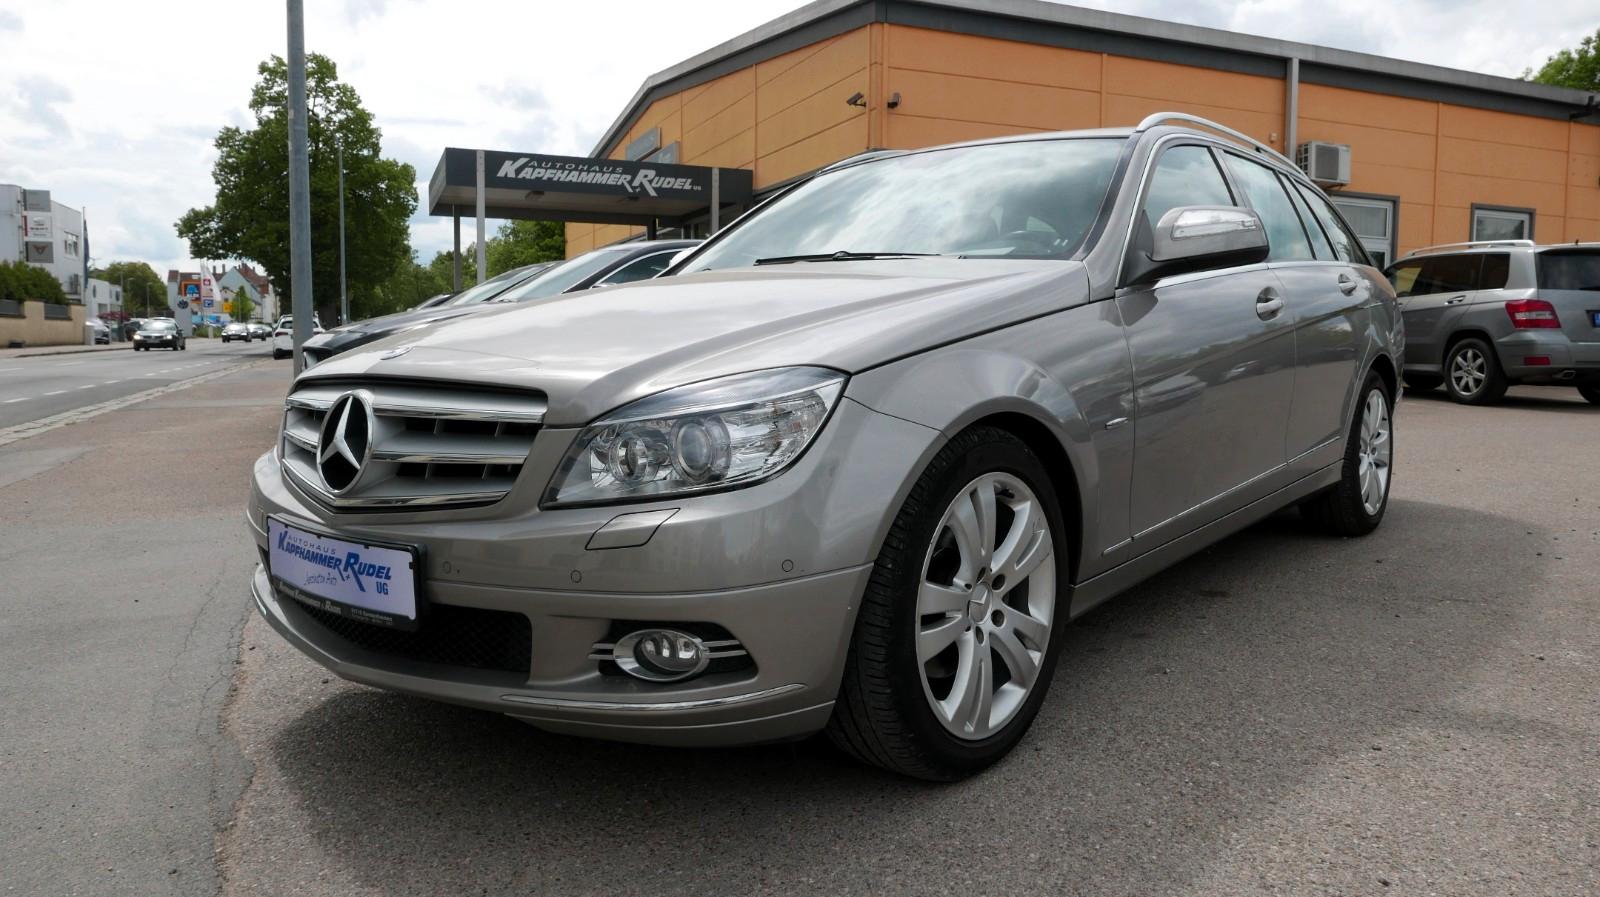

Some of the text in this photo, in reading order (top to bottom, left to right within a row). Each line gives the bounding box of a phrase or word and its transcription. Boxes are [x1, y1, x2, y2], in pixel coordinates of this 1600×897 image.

[496, 157, 634, 193] KAPFHAMMER
[631, 168, 693, 197] RUDEL
[528, 160, 624, 174] AUTOHAUS
[288, 535, 337, 555] AUTOHAUS
[277, 530, 346, 582] KAPFHAMMER
[343, 551, 392, 593] RUDEL
[376, 581, 389, 595] UG
